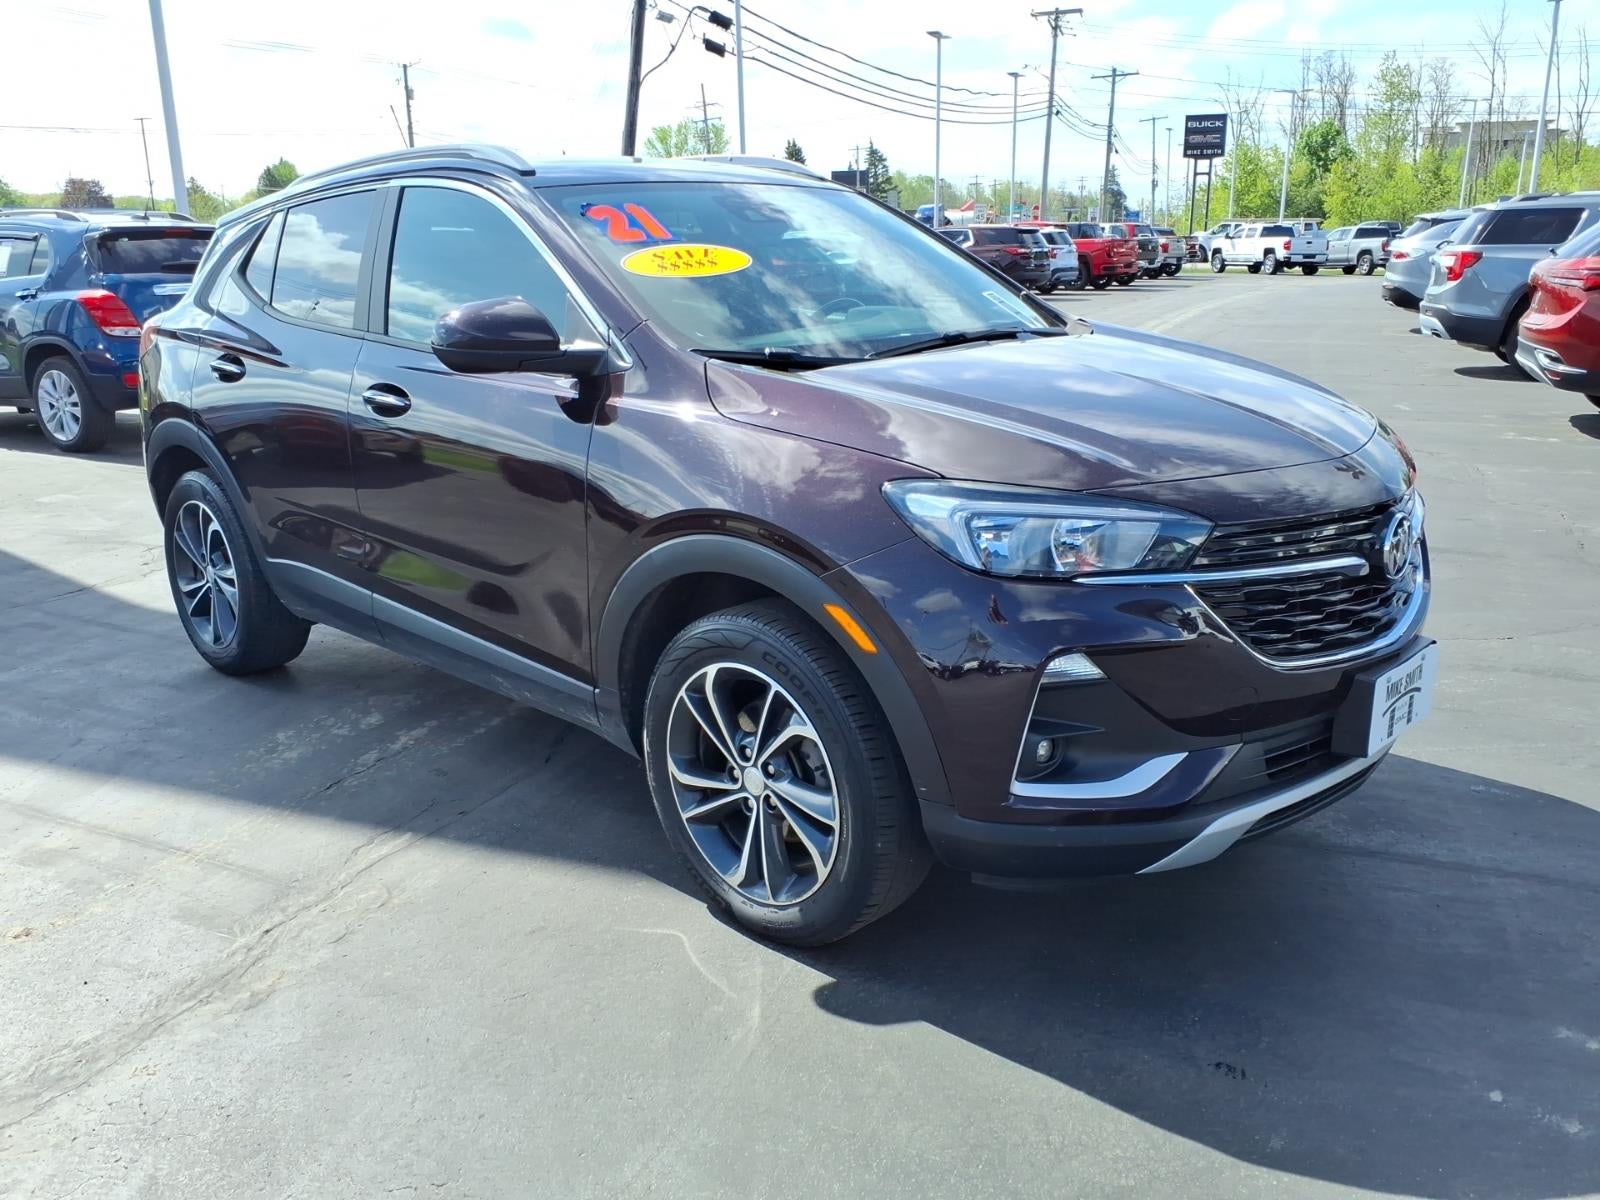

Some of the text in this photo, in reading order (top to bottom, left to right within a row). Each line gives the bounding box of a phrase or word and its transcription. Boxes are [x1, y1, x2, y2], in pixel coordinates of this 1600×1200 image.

[1187, 120, 1224, 128] BUICK
[1189, 134, 1221, 144] GMC
[586, 202, 673, 242] 21
[1385, 664, 1423, 702] MIKE SMITH
